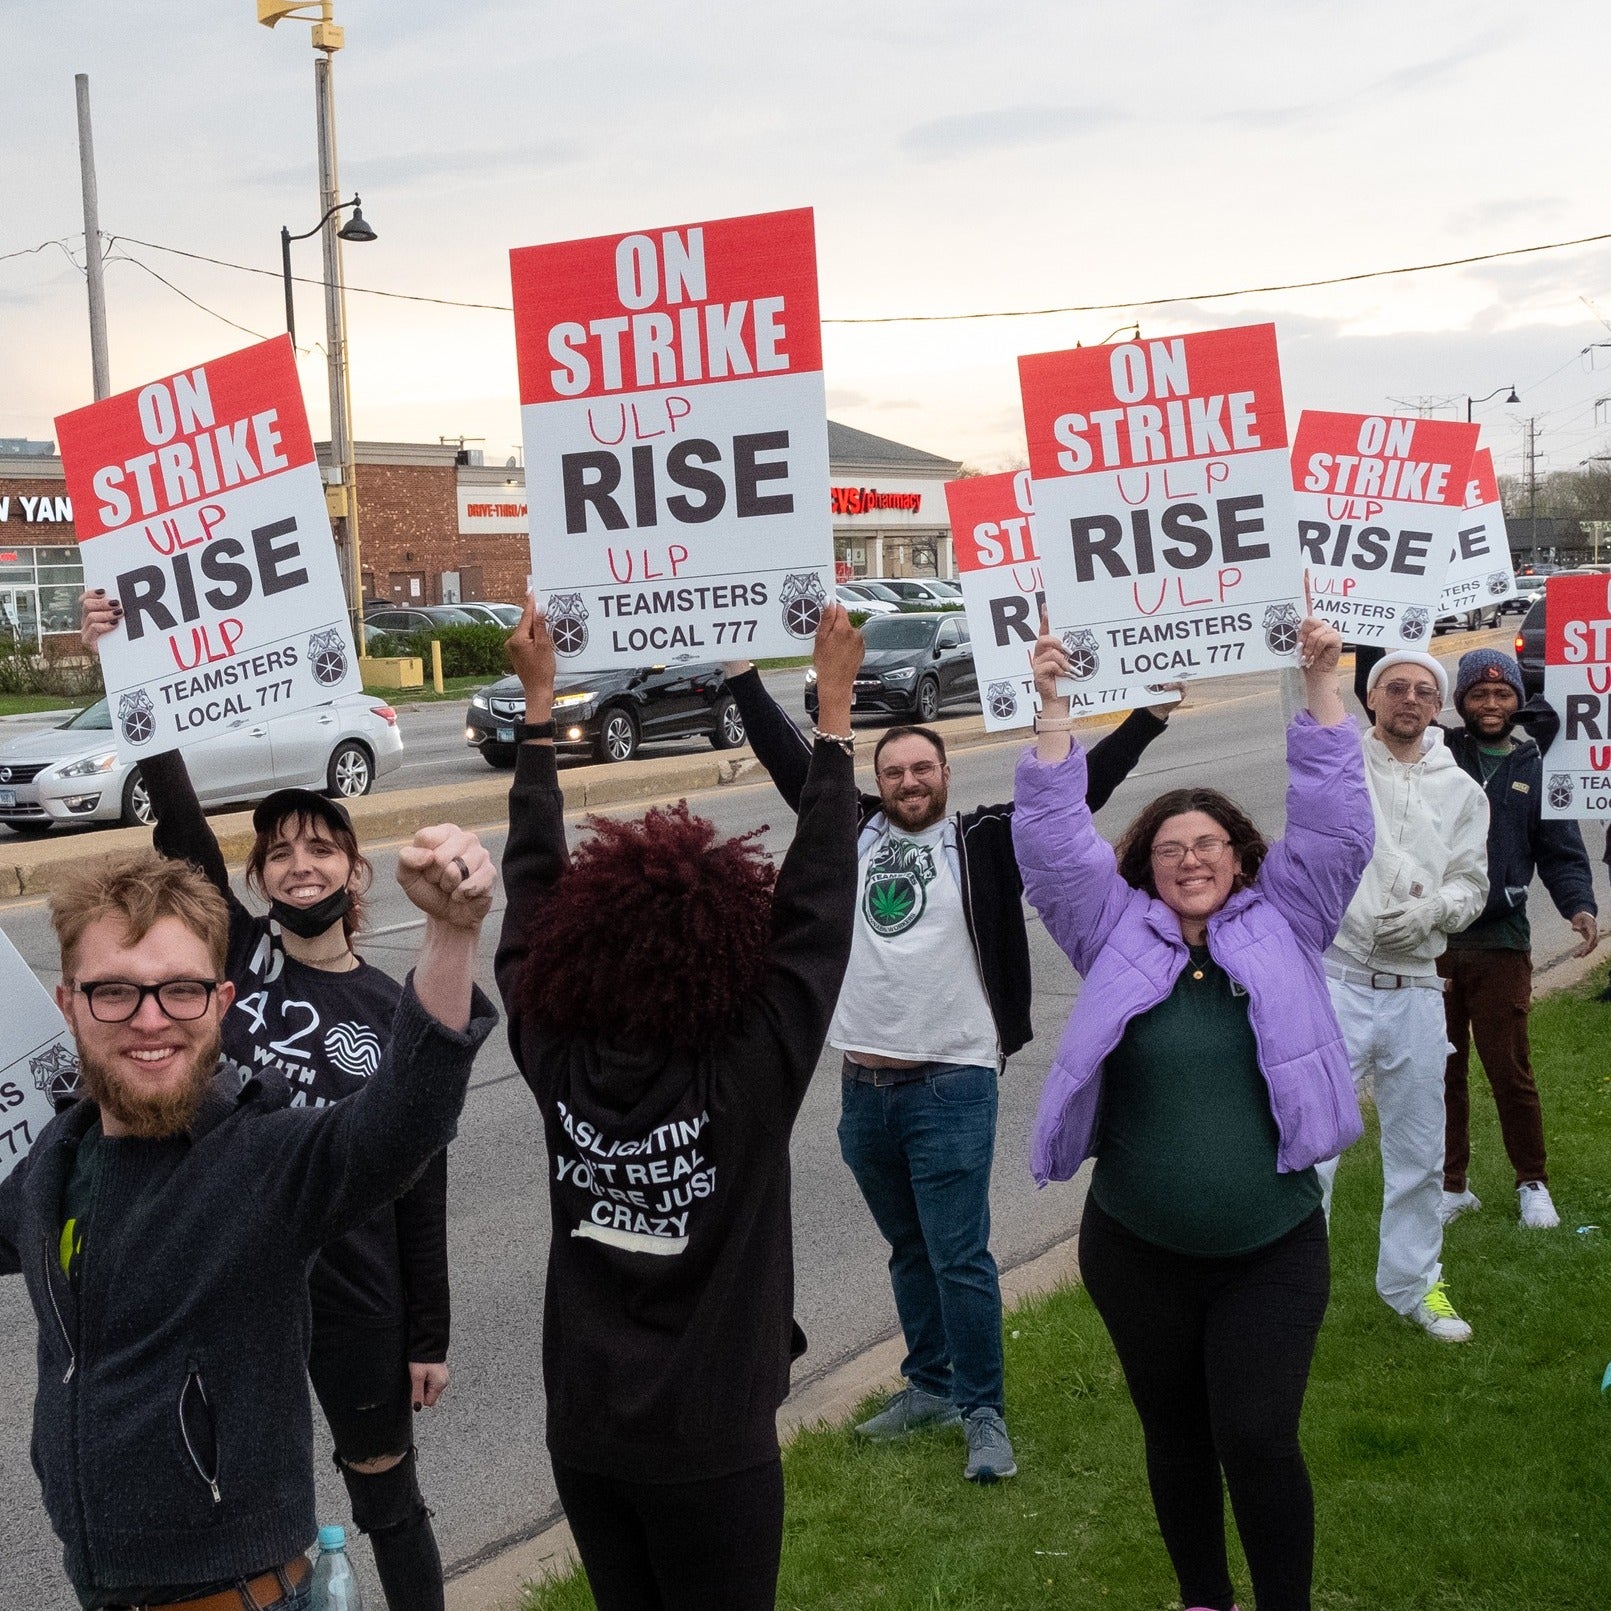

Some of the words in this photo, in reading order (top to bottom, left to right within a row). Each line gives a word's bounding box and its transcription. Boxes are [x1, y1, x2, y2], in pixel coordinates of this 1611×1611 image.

[615, 227, 707, 310] ON
[547, 296, 790, 396] STRIKE
[1110, 338, 1190, 404] ON
[138, 367, 216, 446] ON
[587, 396, 691, 446] ULP
[1053, 390, 1262, 473] STRIKE
[1356, 416, 1416, 459] ON
[92, 408, 290, 528] STRIKE
[561, 430, 794, 535] RISE
[1116, 461, 1229, 505] ULP
[1304, 452, 1452, 503] STRIKE
[144, 504, 227, 557] ULP
[1326, 497, 1384, 523] ULP
[1069, 493, 1271, 583] RISE
[1297, 519, 1434, 577] RISE
[117, 516, 309, 641] RISE
[607, 544, 689, 584] ULP
[1314, 576, 1356, 597] ULP
[597, 582, 768, 618] TEAMSTERS
[1133, 567, 1242, 616] ULP
[1311, 598, 1396, 620] AMSTERS
[1440, 580, 1481, 598] TERS
[1454, 594, 1477, 609] 777
[168, 617, 244, 672] ULP
[612, 624, 704, 653] LOCAL
[711, 619, 758, 646] 777
[1107, 612, 1253, 648] TEAMSTERS
[1357, 622, 1385, 638] 777
[159, 646, 299, 705] TEAMSTERS
[1120, 646, 1201, 675] LOCAL
[1206, 642, 1246, 666] 777
[173, 692, 252, 733] LOCAL
[255, 679, 294, 709] 777
[1099, 687, 1128, 704] 777
[1565, 693, 1611, 741] R
[254, 1044, 316, 1085] WITH
[0, 1119, 34, 1163] 77
[625, 1148, 705, 1185] REAL
[655, 1166, 717, 1213] JUST
[590, 1200, 689, 1238] CRAZY
